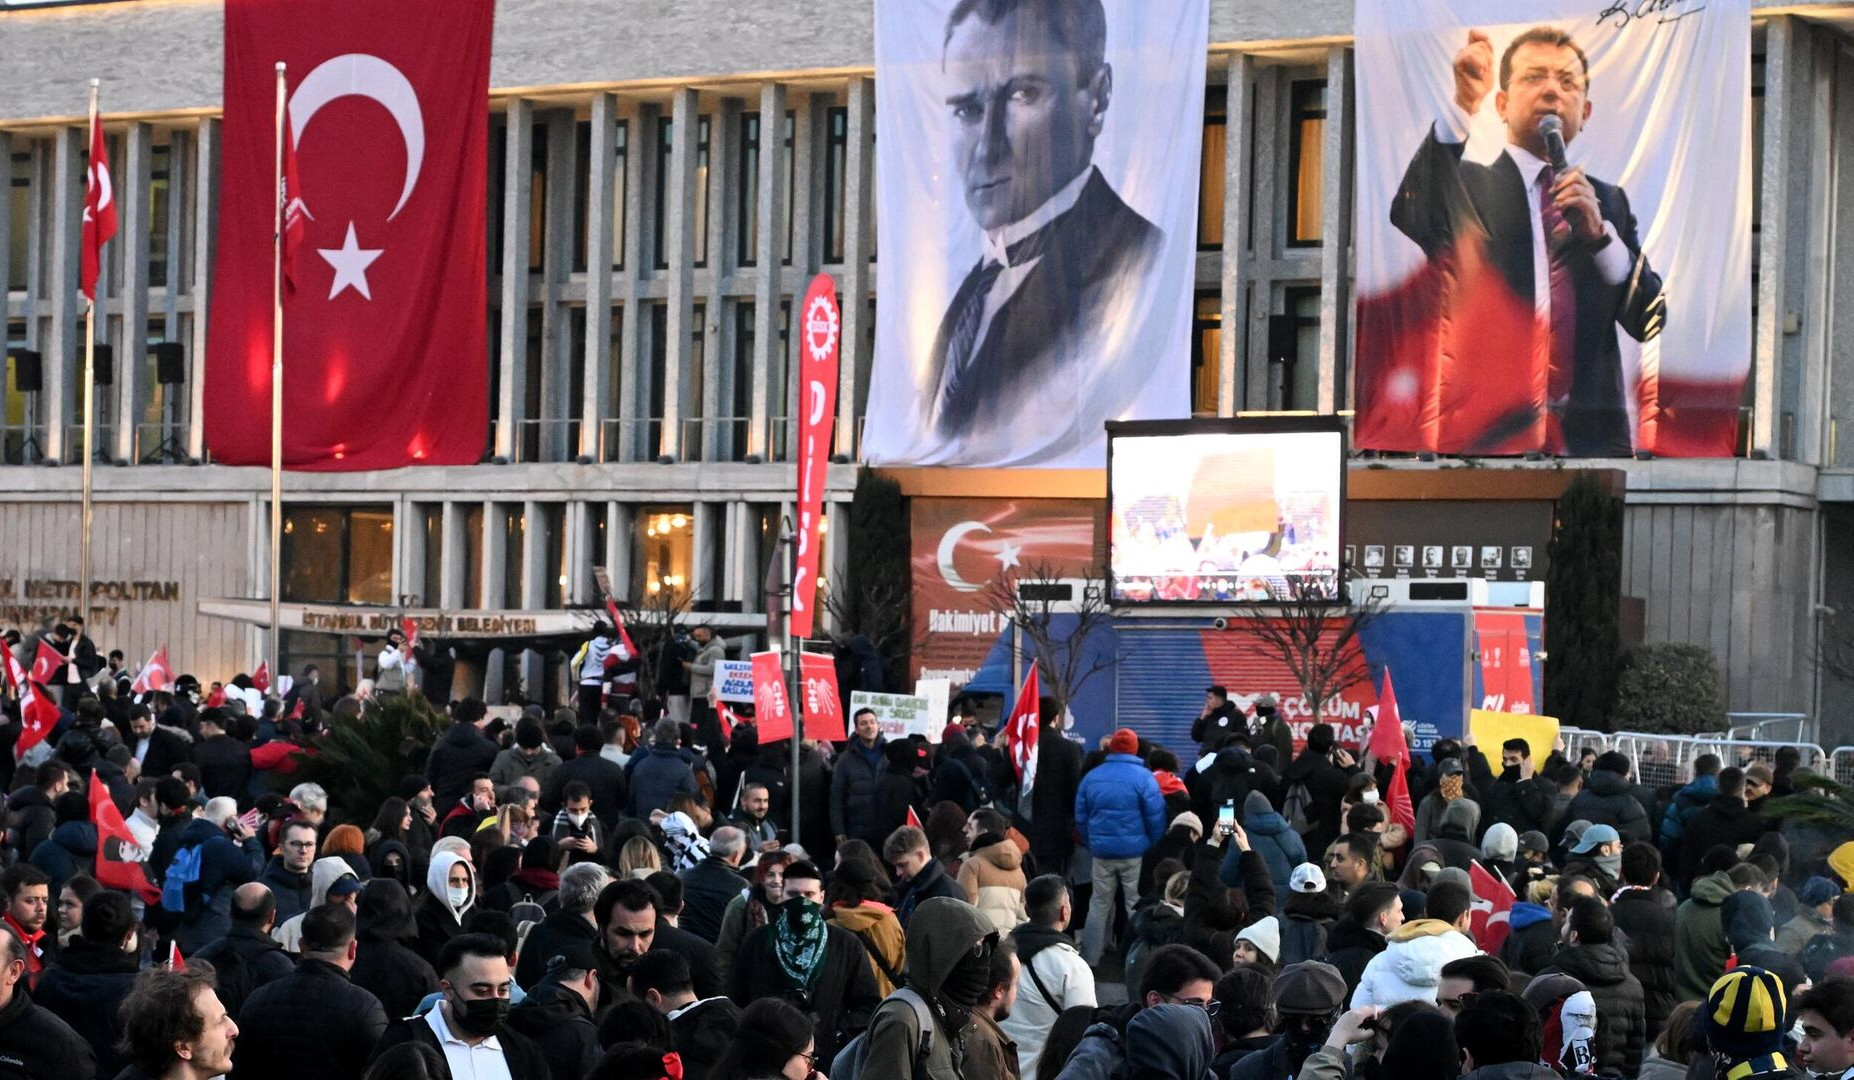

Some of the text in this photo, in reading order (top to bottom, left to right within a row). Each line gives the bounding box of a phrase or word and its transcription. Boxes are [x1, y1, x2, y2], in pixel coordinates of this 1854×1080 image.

[24, 580, 179, 601] METRPOLITAN
[772, 680, 785, 718] CHP
[808, 678, 819, 714] CHP
